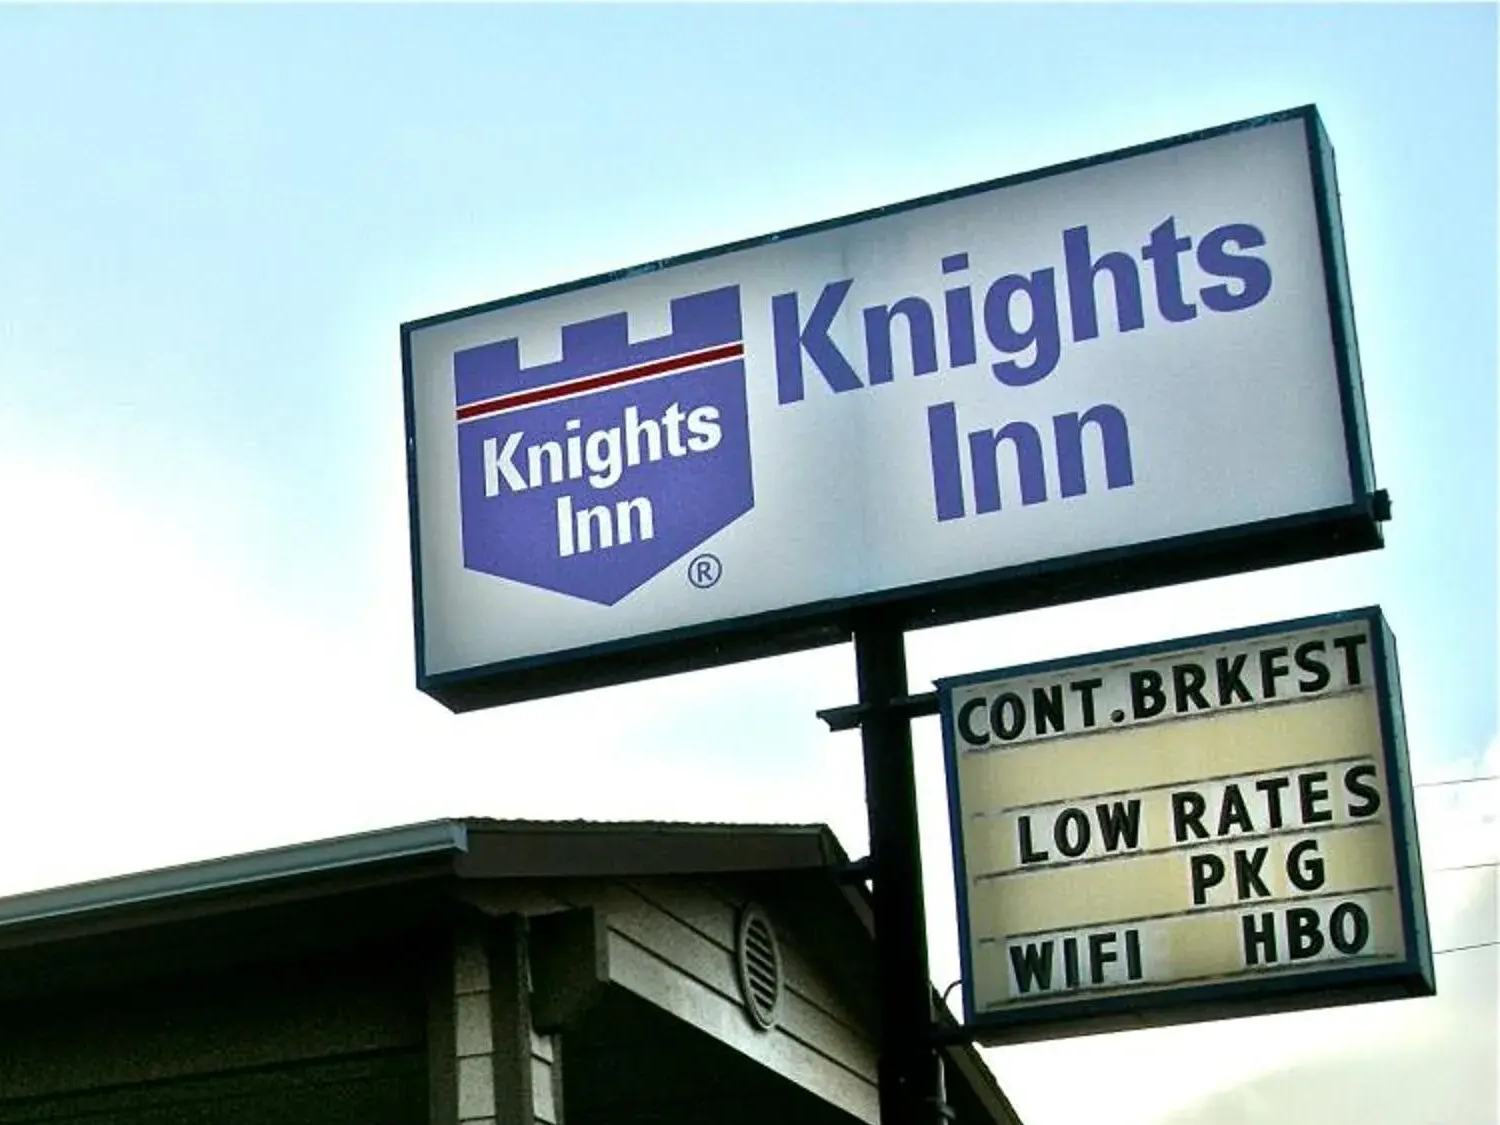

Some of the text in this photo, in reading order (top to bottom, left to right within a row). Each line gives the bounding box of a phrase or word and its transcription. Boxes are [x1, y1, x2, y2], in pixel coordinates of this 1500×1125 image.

[773, 216, 1273, 405] Knights
[482, 403, 723, 497] Knights
[928, 402, 1134, 522] Inn
[557, 495, 654, 556] Inn
[1018, 765, 1381, 865] LOW RATES
[1191, 840, 1326, 905] PKG
[1009, 902, 1370, 994] WIFI HBO
